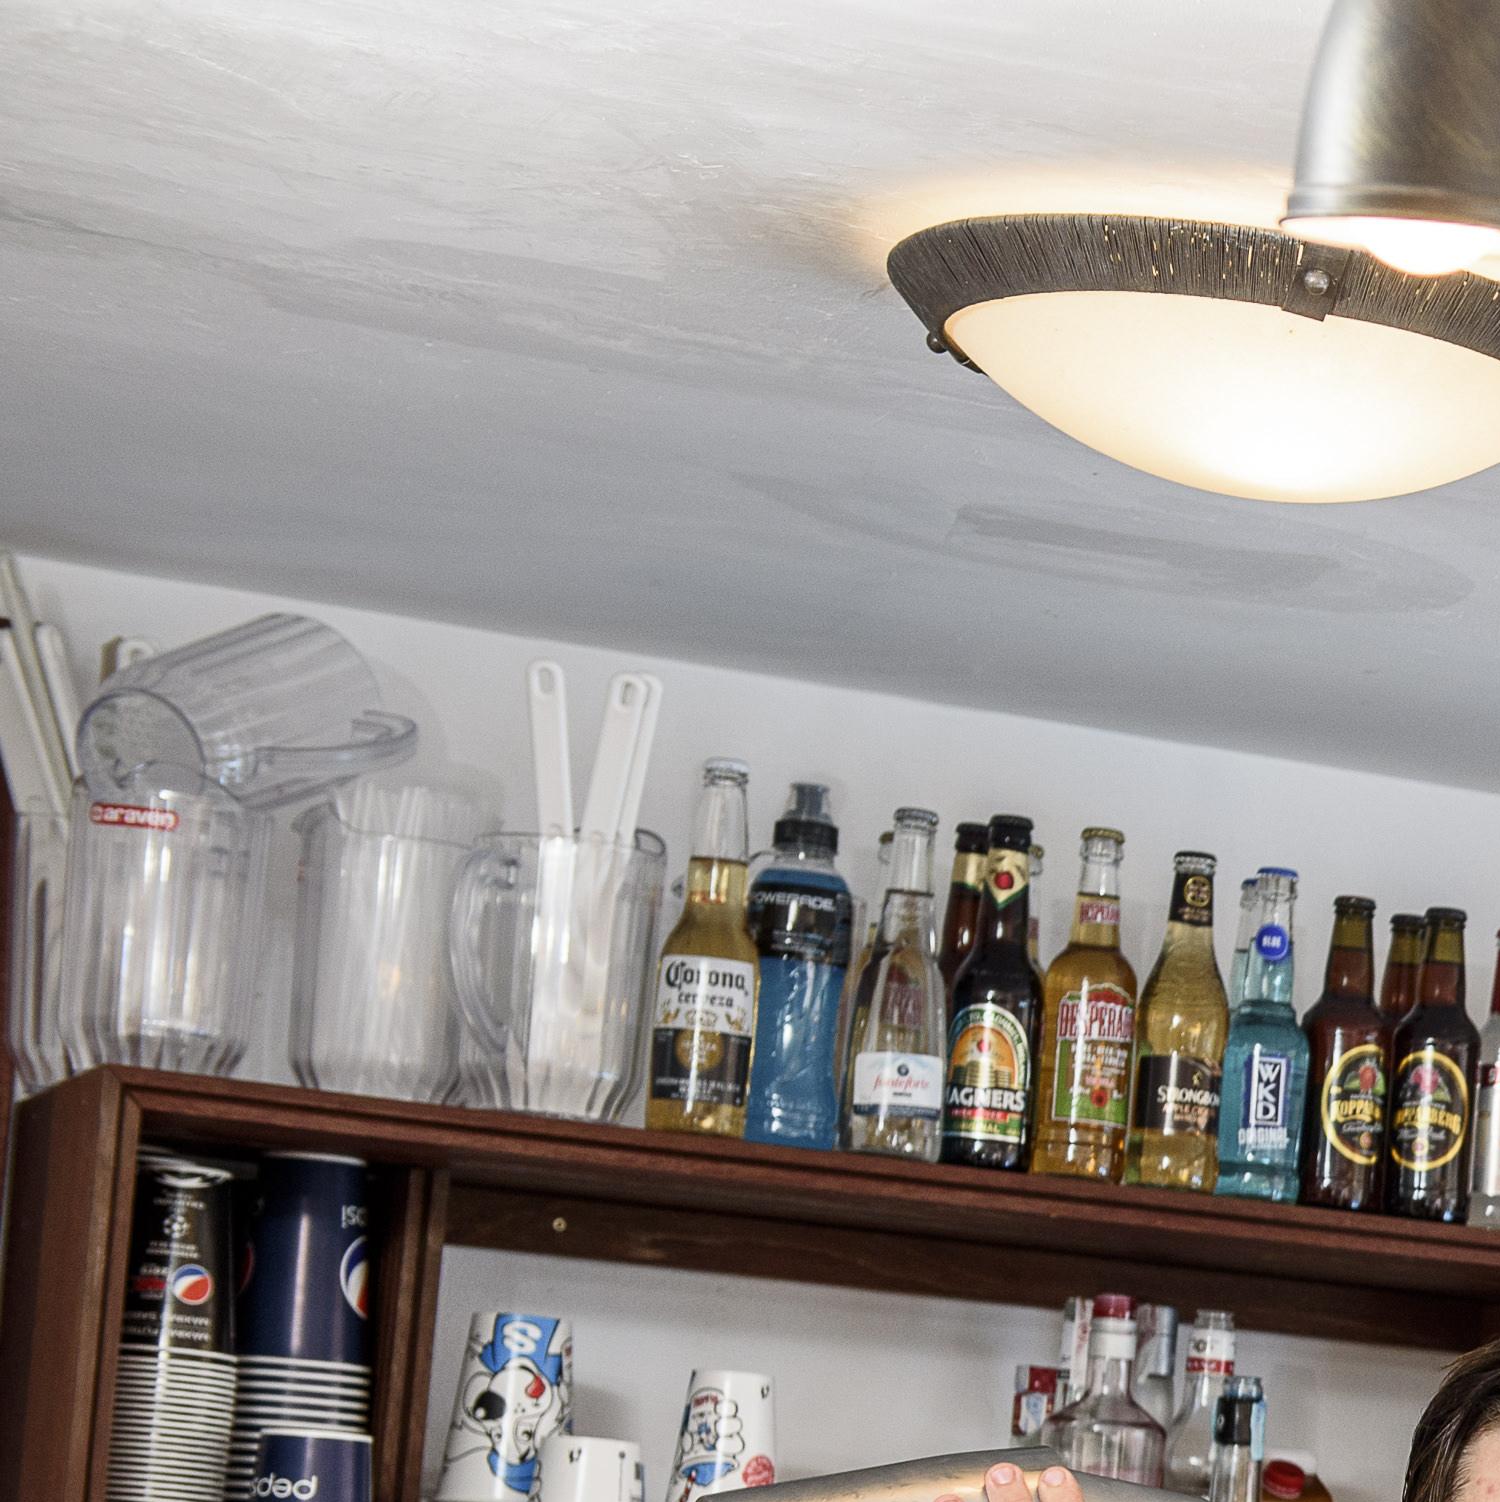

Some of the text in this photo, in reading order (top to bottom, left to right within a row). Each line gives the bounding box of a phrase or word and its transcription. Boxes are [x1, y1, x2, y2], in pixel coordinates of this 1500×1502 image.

[677, 991, 734, 1008] cereza
[948, 1087, 1027, 1112] AGNERS
[1157, 1084, 1221, 1106] SRONGBO
[250, 1472, 318, 1500] peps
